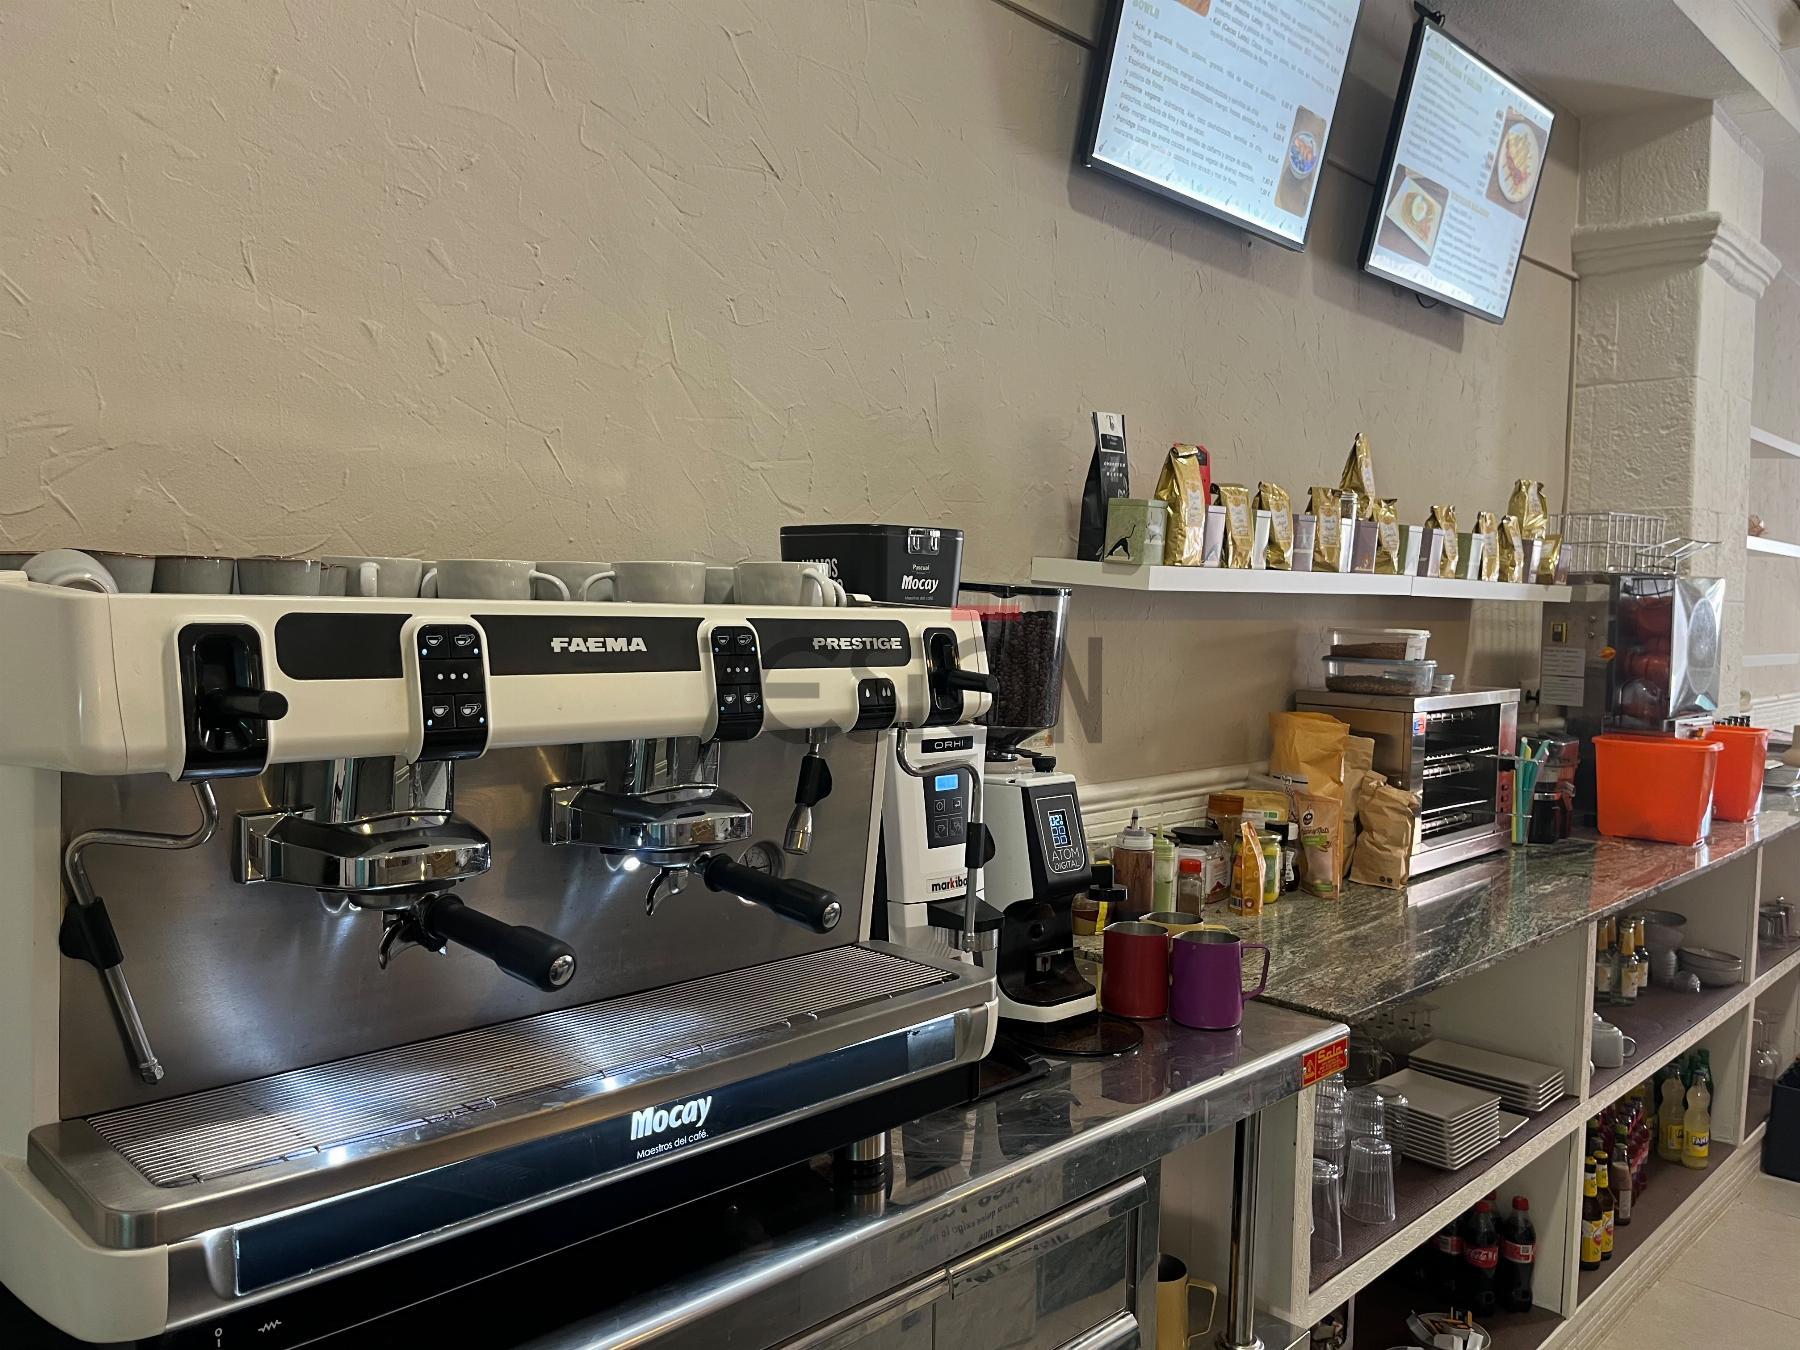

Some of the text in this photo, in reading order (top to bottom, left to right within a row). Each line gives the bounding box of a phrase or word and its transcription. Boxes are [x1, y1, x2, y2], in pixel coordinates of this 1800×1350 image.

[901, 574, 939, 594] Mocay
[550, 636, 648, 653] FAEMA
[812, 636, 903, 651] PRESTIGE
[933, 739, 964, 750] ORHI
[1051, 846, 1081, 862] ATOM
[1054, 860, 1081, 871] DIGITAL
[630, 1095, 713, 1141] Mocay
[636, 1129, 709, 1160] Maestros del café.
